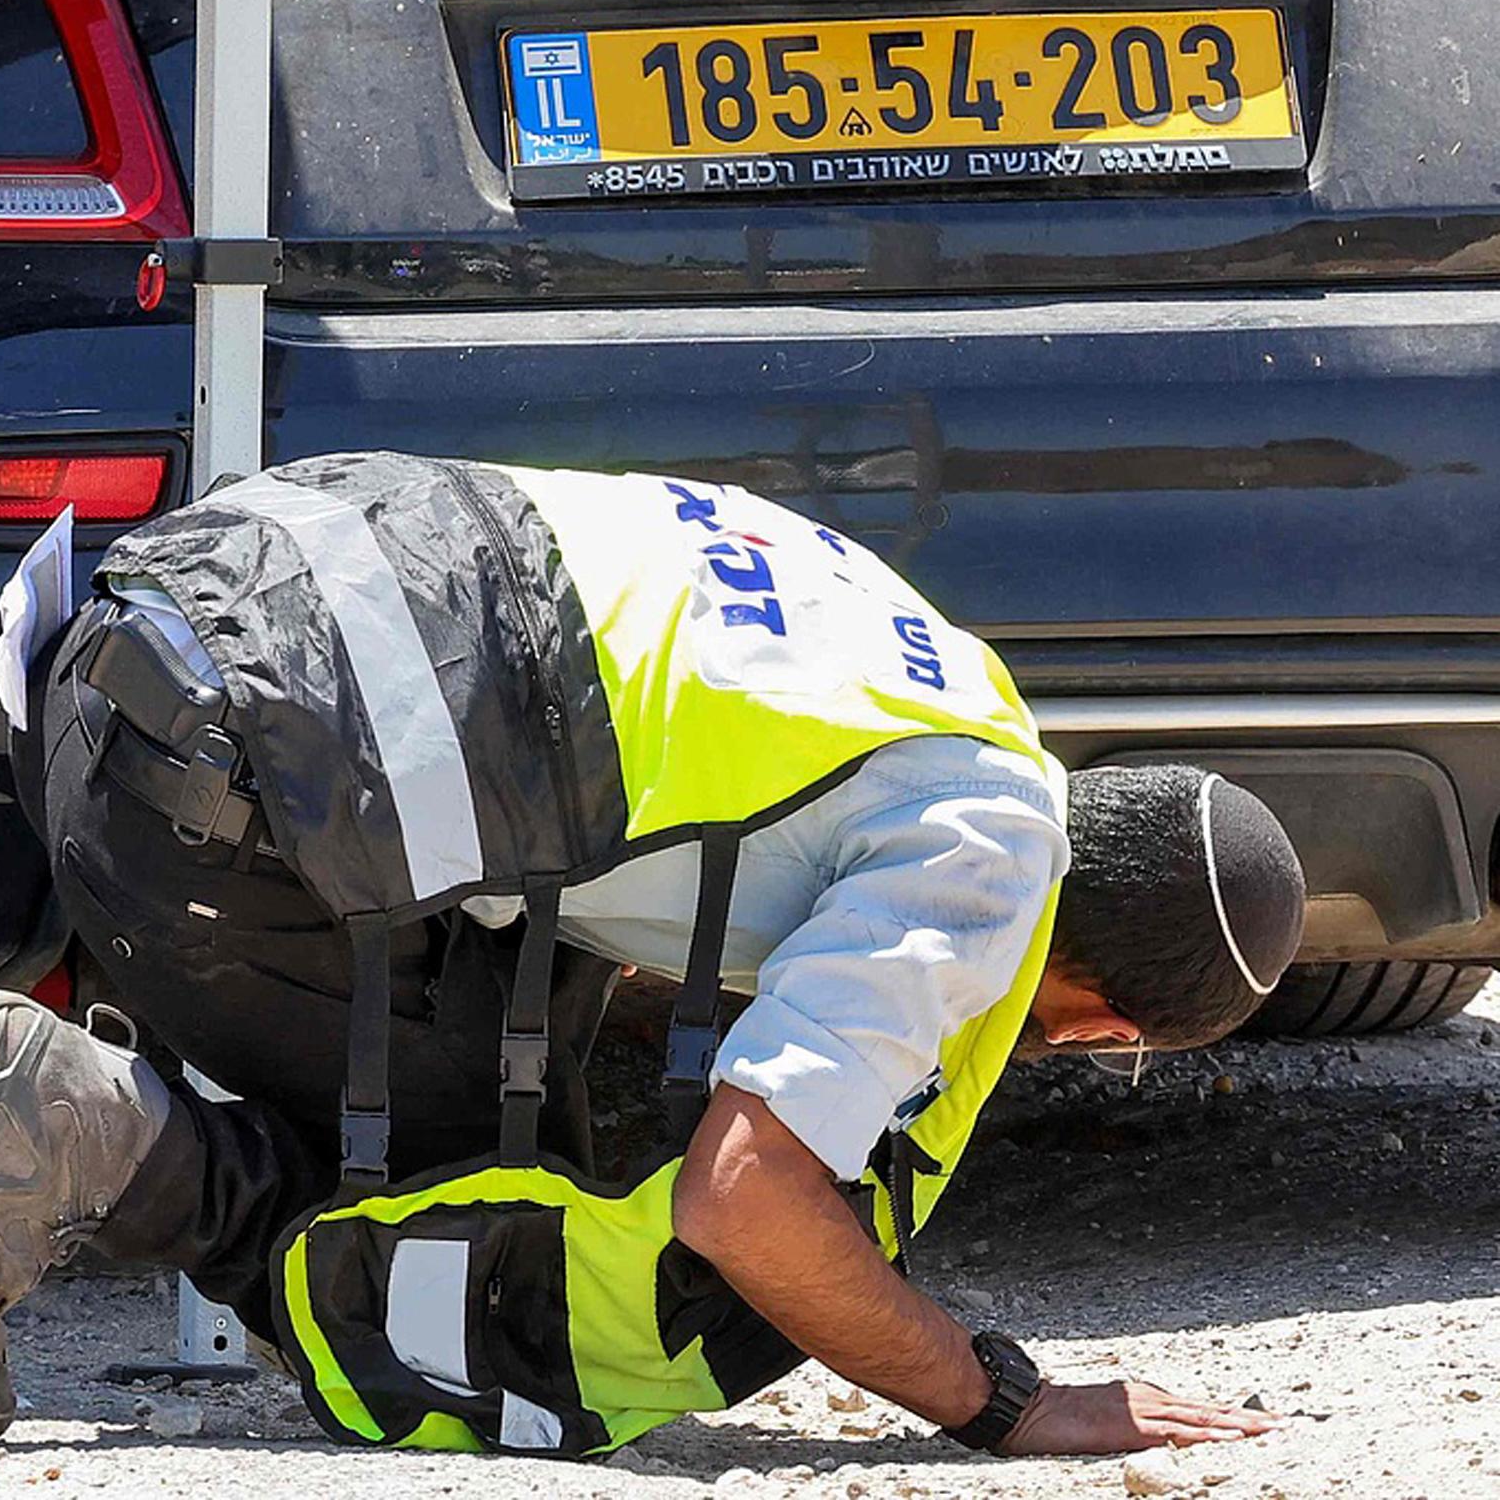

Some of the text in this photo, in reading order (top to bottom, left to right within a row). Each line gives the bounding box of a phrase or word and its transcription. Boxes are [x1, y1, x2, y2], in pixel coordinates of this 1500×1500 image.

[536, 77, 582, 129] IL
[526, 130, 591, 147] ישראל
[703, 159, 796, 186] רכבים
[812, 153, 950, 182] שאוהבים
[968, 144, 1083, 177] לאנשים
